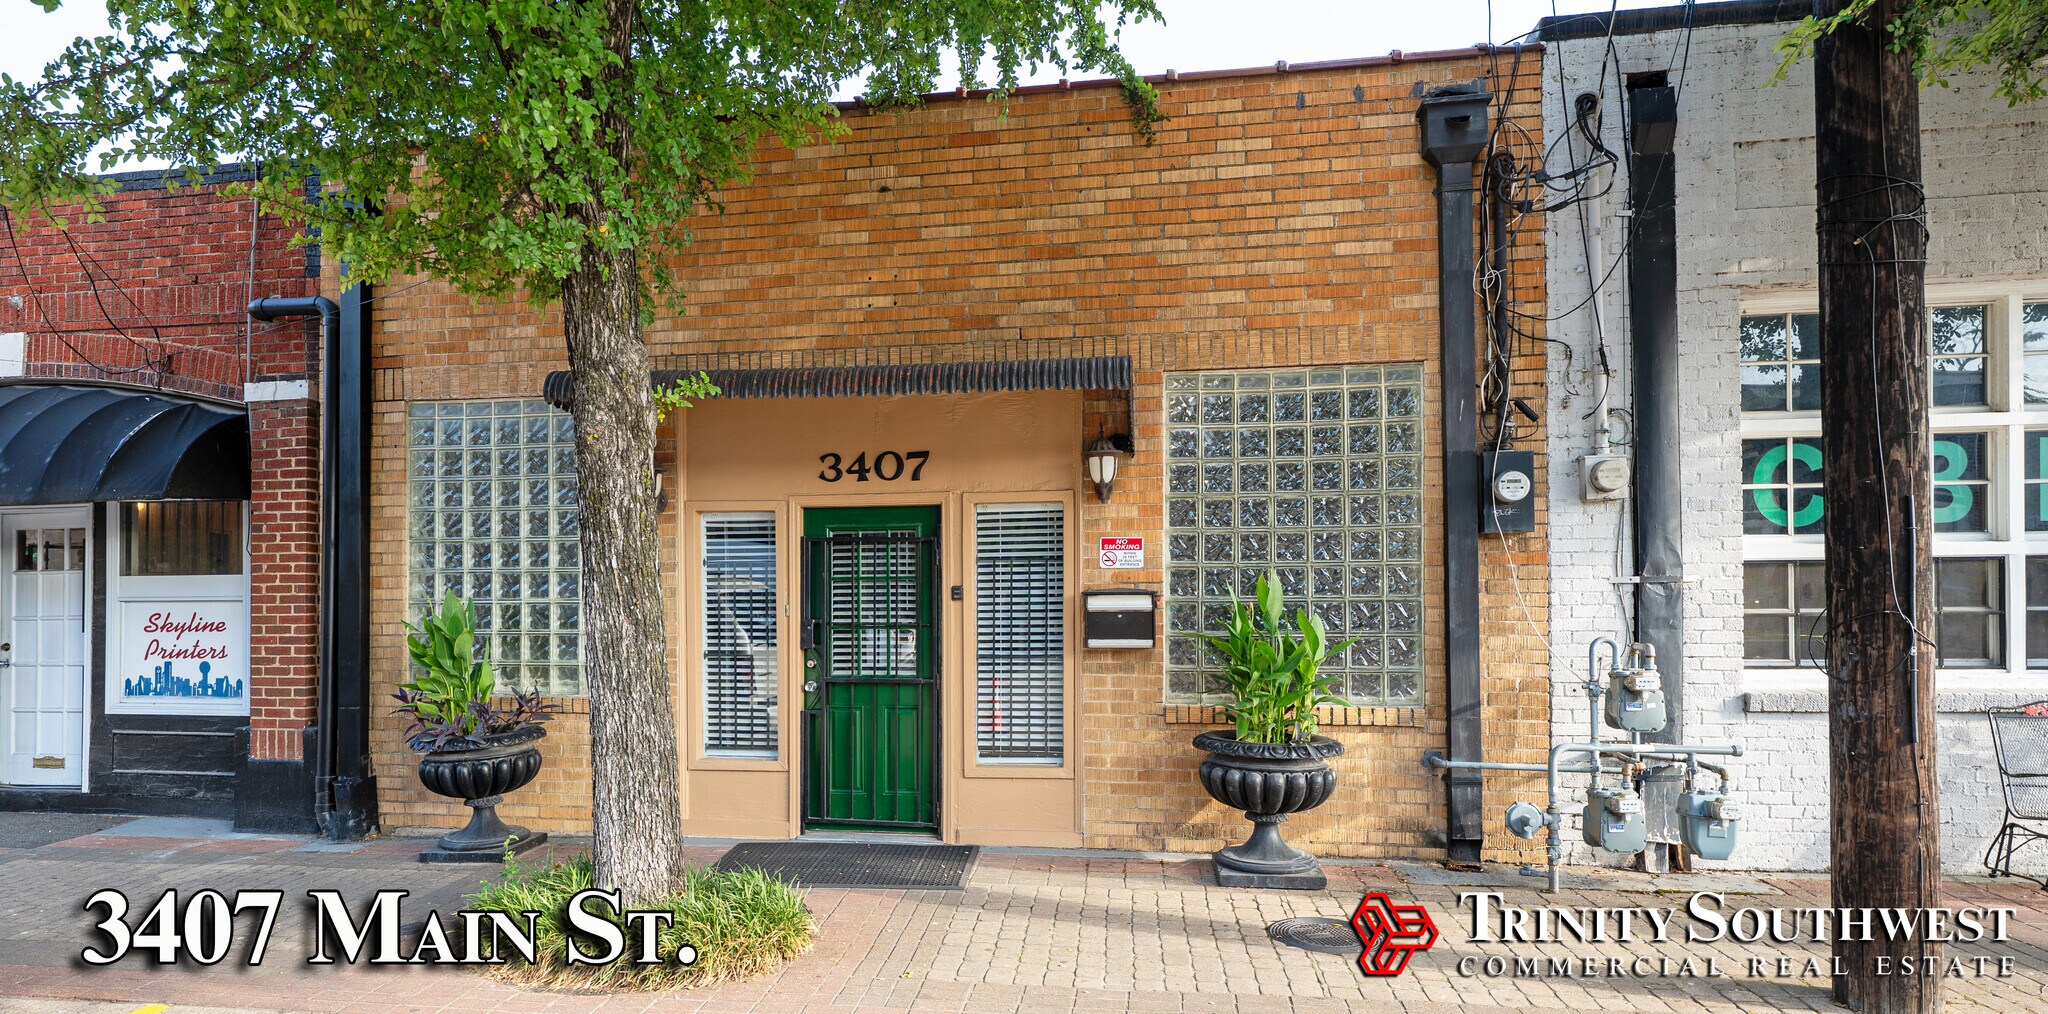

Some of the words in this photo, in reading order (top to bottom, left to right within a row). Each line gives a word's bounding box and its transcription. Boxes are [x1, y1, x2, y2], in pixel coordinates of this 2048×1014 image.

[818, 450, 930, 482] 3407
[143, 611, 227, 641] Skyline
[144, 639, 228, 661] Printers
